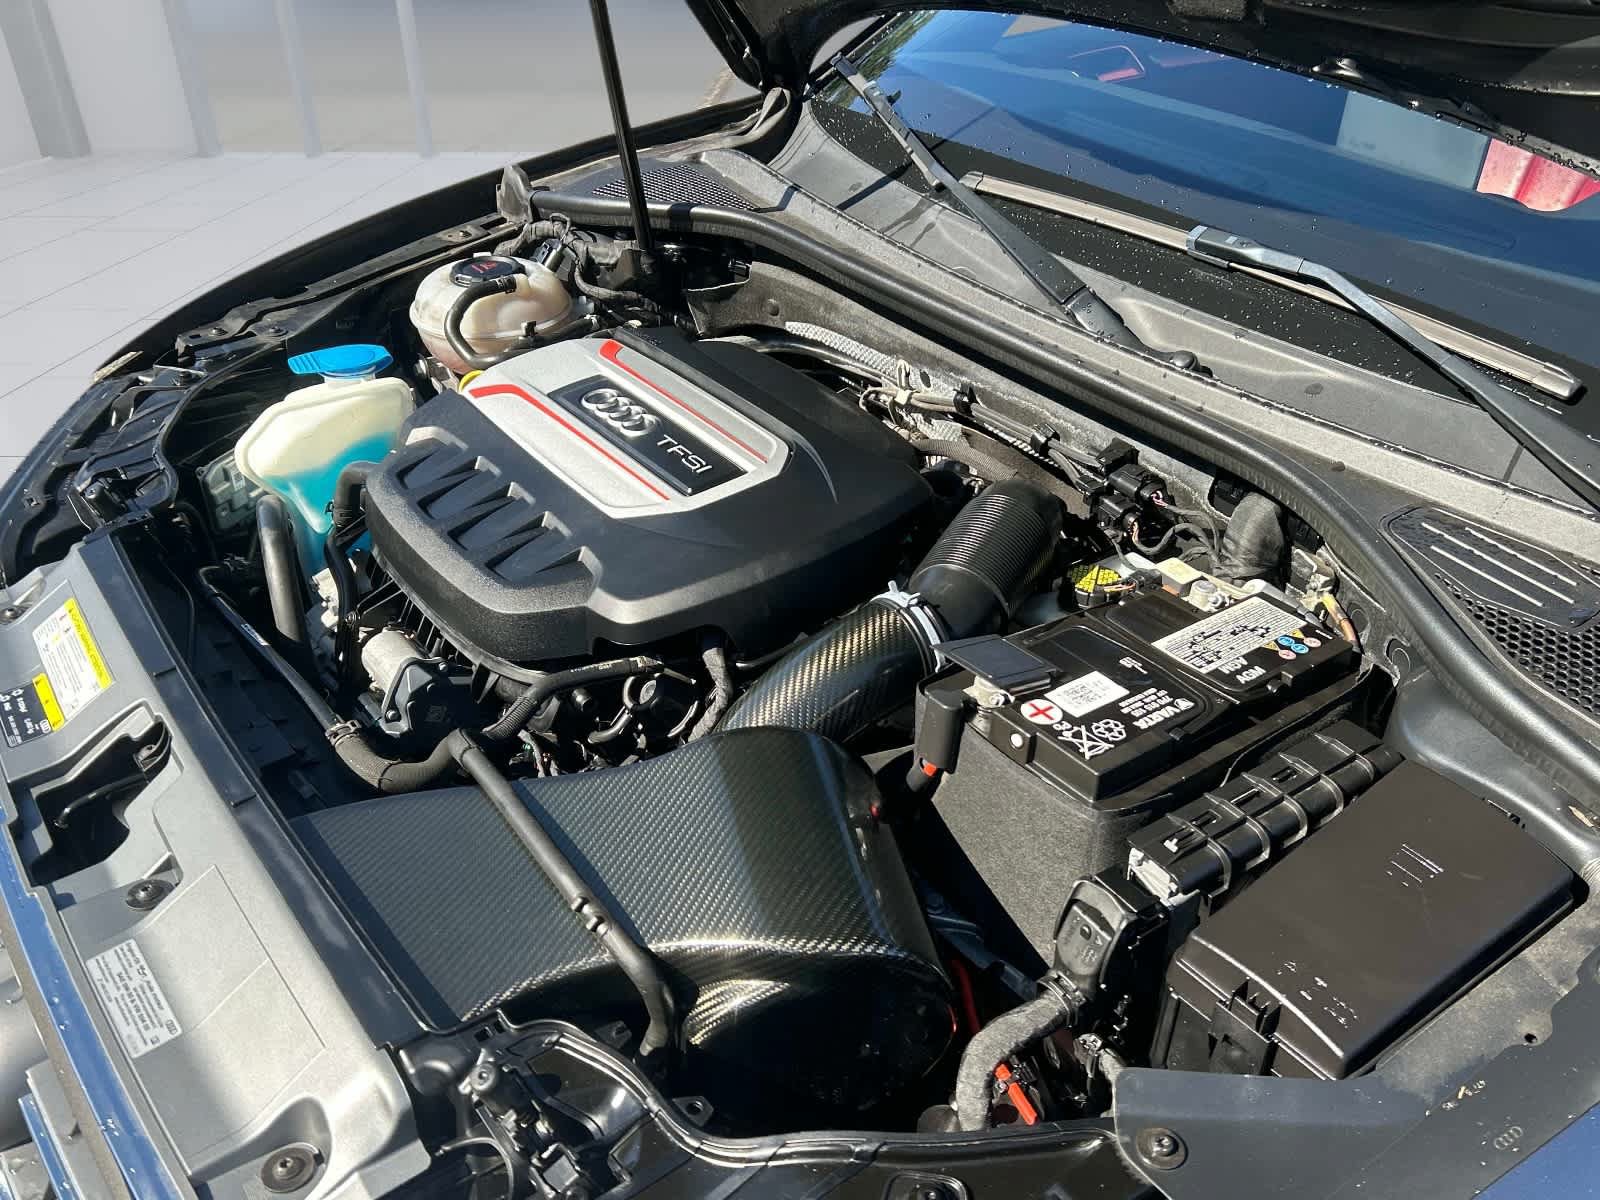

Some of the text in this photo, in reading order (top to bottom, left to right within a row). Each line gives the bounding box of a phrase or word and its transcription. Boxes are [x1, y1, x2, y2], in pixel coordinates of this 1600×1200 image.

[657, 434, 712, 473] TFSI
[1235, 665, 1267, 685] AGM
[1132, 705, 1181, 730] VARTA
